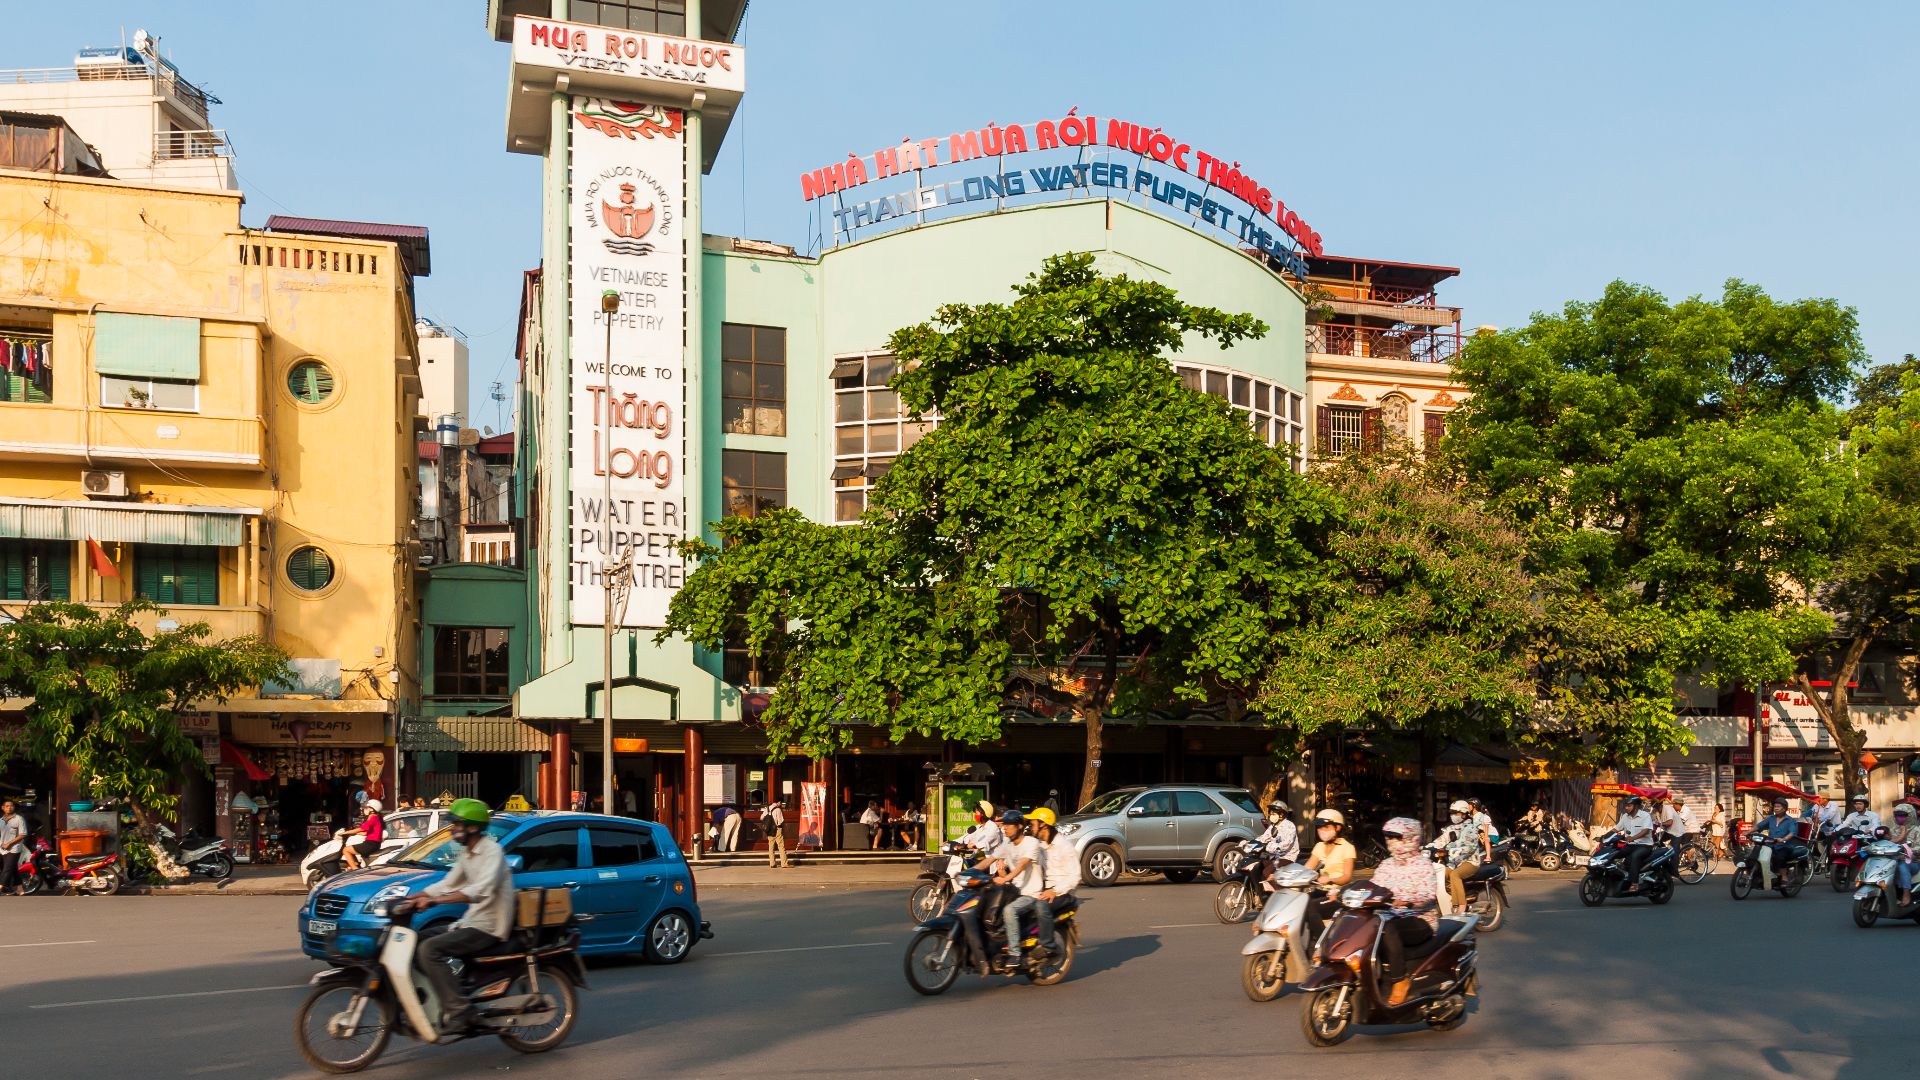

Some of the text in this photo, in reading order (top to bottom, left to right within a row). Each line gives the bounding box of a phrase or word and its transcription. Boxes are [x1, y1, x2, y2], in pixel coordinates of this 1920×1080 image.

[531, 23, 731, 71] MUA ROI NUOC
[557, 54, 706, 84] VIET NAM
[585, 166, 673, 236] MUA ROI NUOC THANG LONG
[800, 152, 868, 201] NHÀ
[950, 121, 1028, 163] MÚA
[1277, 200, 1323, 257] LONG
[833, 161, 1310, 283] THANG LONG WATER PUPPET THEATRE
[589, 265, 668, 288] VIETNAMESE
[601, 290, 657, 308] ATER
[593, 311, 664, 331] PUPPETRY
[654, 367, 672, 380] TO
[586, 385, 671, 440] Thăng
[594, 430, 672, 489] Long
[580, 497, 679, 528] WATER
[580, 529, 678, 558] PUPPET
[271, 720, 353, 731] HACRAFTS
